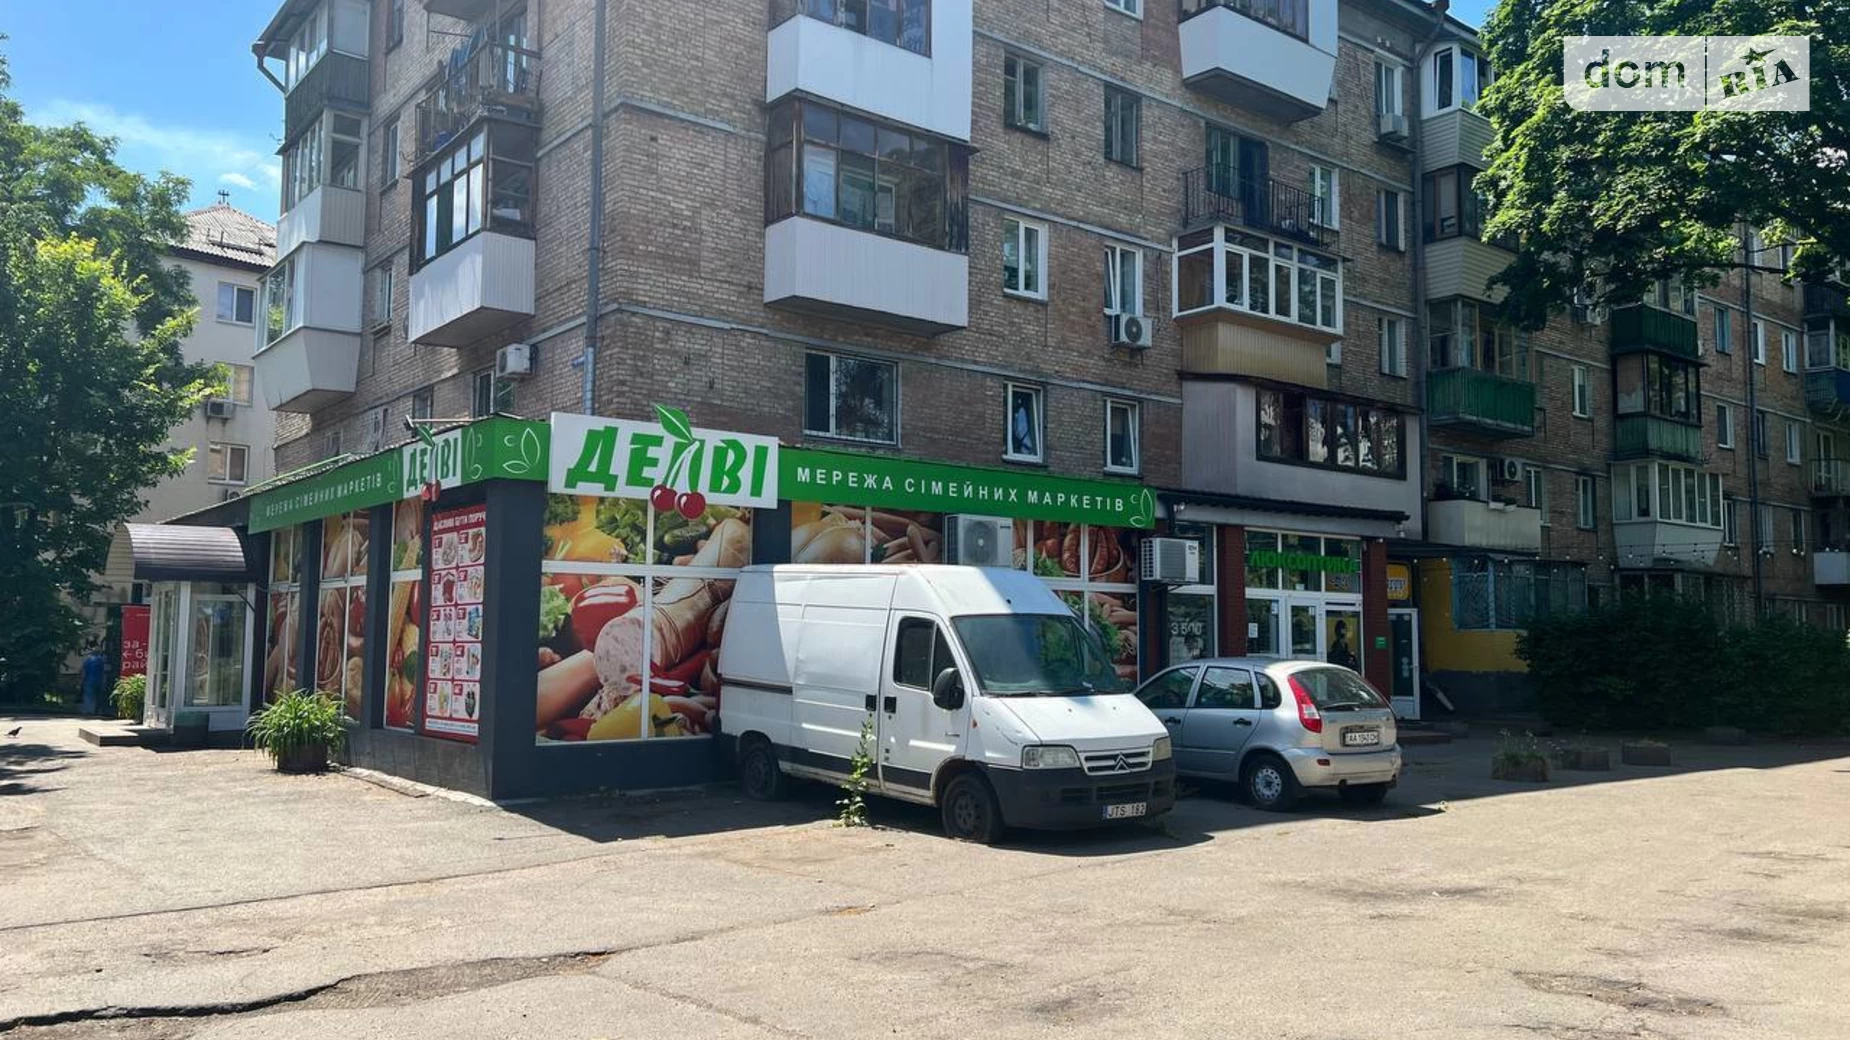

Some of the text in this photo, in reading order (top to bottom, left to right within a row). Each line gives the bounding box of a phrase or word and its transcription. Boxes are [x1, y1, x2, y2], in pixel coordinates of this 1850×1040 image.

[564, 426, 770, 498] ДЕЛВІ
[796, 466, 1125, 512] МЕРЕЖА СІМЕЙНИХ МАРКЕТІВ
[1108, 806, 1127, 817] JTS
